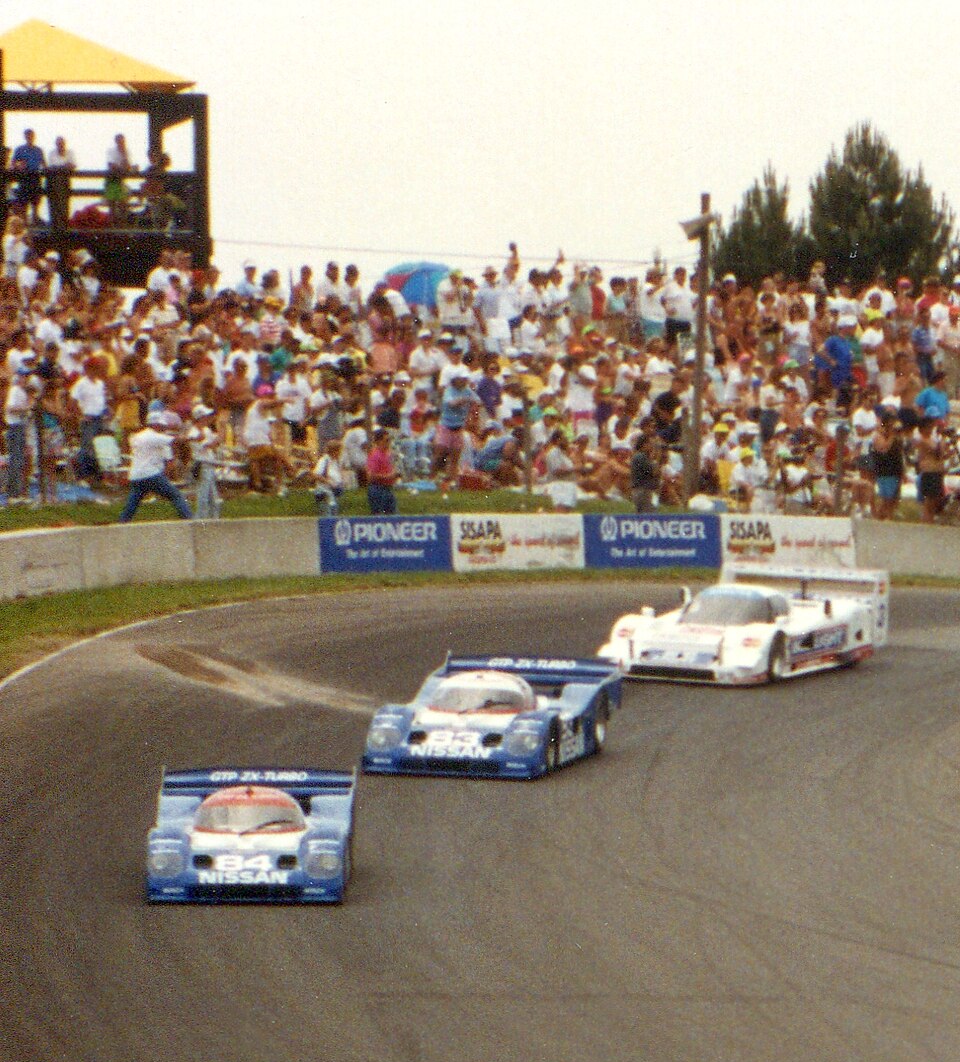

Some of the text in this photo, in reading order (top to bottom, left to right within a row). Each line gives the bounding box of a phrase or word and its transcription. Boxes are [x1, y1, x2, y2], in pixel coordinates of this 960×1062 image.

[353, 522, 437, 542] PIONEER
[620, 520, 706, 540] PIONEER
[410, 744, 493, 759] NISSAN
[198, 871, 289, 884] NISSAN
